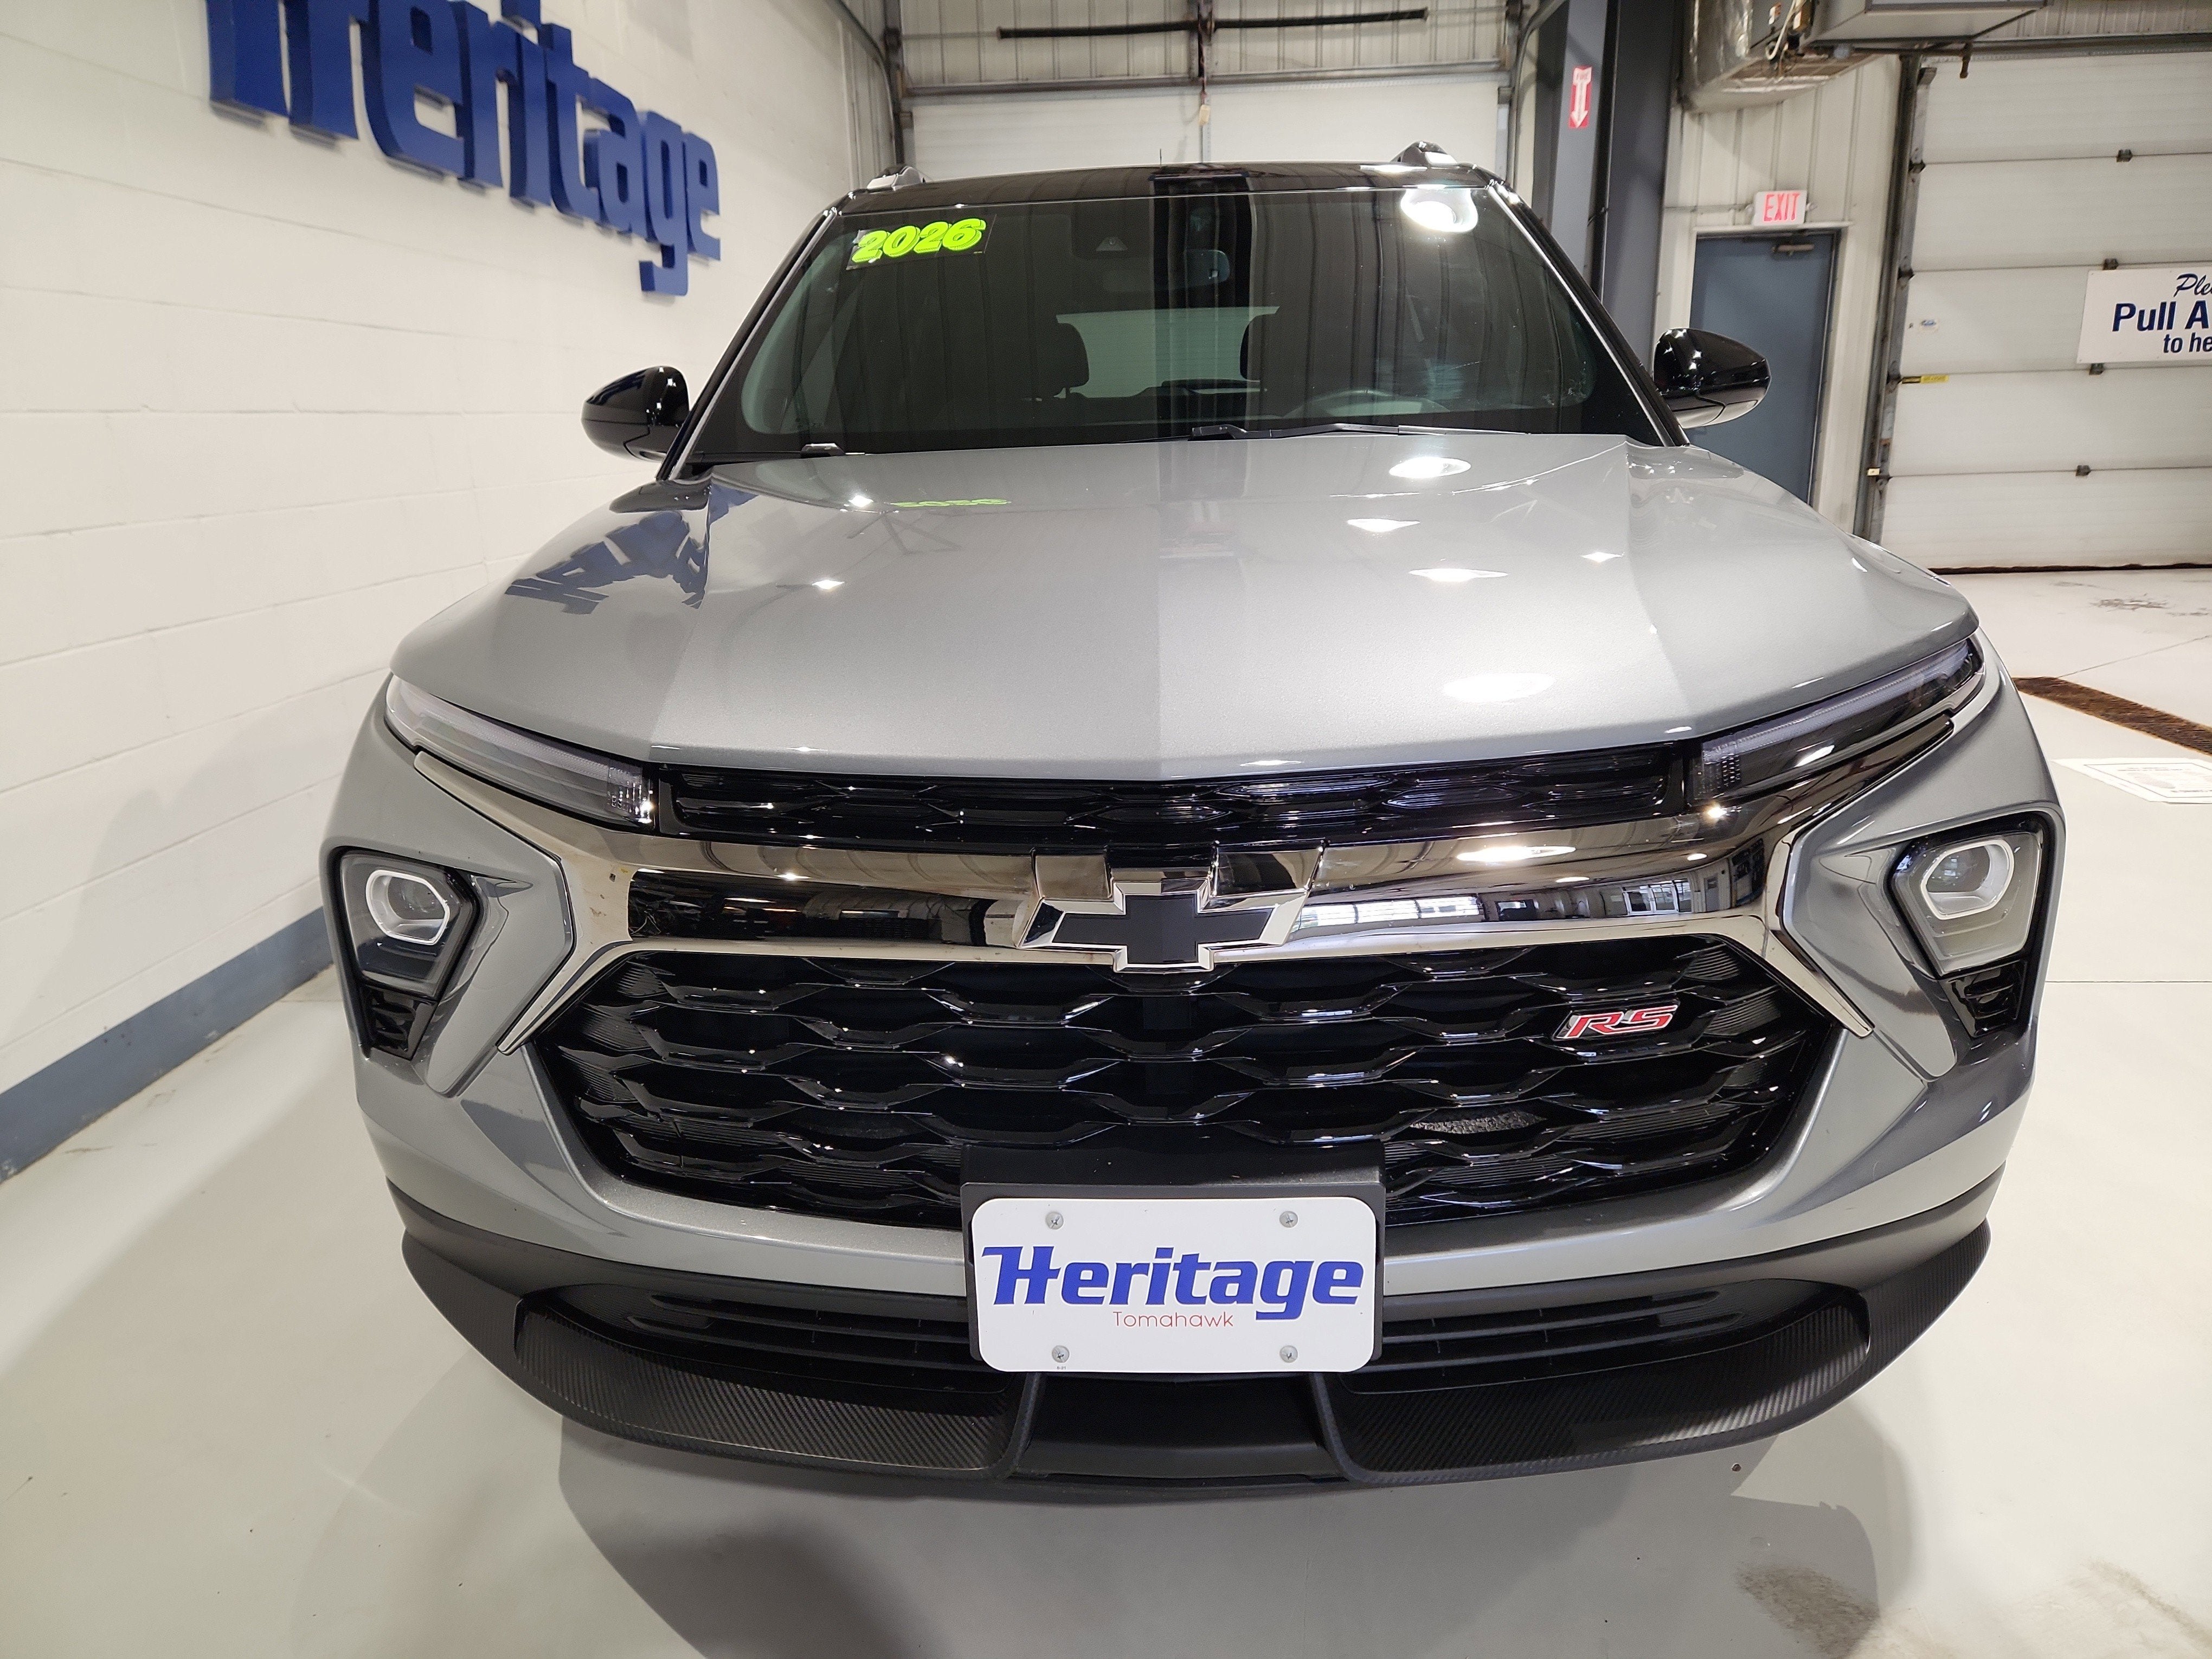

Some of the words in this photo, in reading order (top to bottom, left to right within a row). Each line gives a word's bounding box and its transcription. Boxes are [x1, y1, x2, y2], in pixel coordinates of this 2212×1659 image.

[1764, 192, 1801, 222] EXIT
[851, 218, 986, 263] 2026
[2173, 273, 2212, 297] Ple
[2112, 301, 2176, 332] Pull
[2163, 334, 2183, 353] to
[1557, 1004, 1677, 1039] RS
[982, 1246, 1364, 1320] Heritage
[1113, 1311, 1234, 1328] Tomahawk
